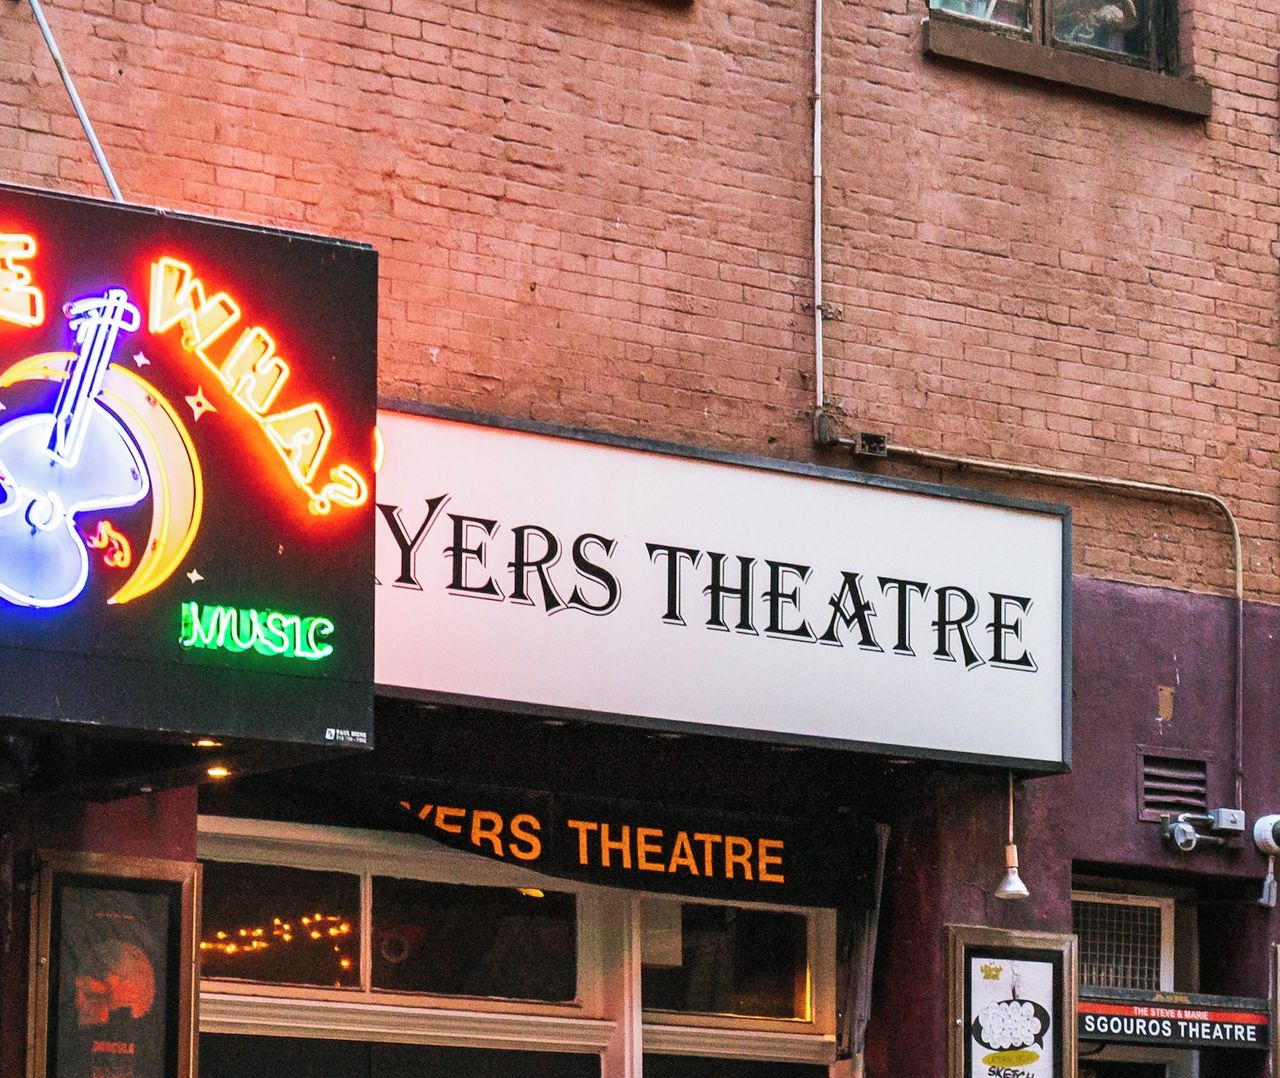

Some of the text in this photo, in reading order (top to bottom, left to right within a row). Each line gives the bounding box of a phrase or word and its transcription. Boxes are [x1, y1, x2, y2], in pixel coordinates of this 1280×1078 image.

[150, 256, 370, 515] WHA?
[374, 493, 1038, 672] YERS THEATRE
[179, 602, 335, 659] MUSIC
[567, 820, 786, 883] THEATRE
[1084, 1015, 1257, 1042] SGOUROS THEATRE
[1133, 1006, 1210, 1021] THE STEVE & MARIE
